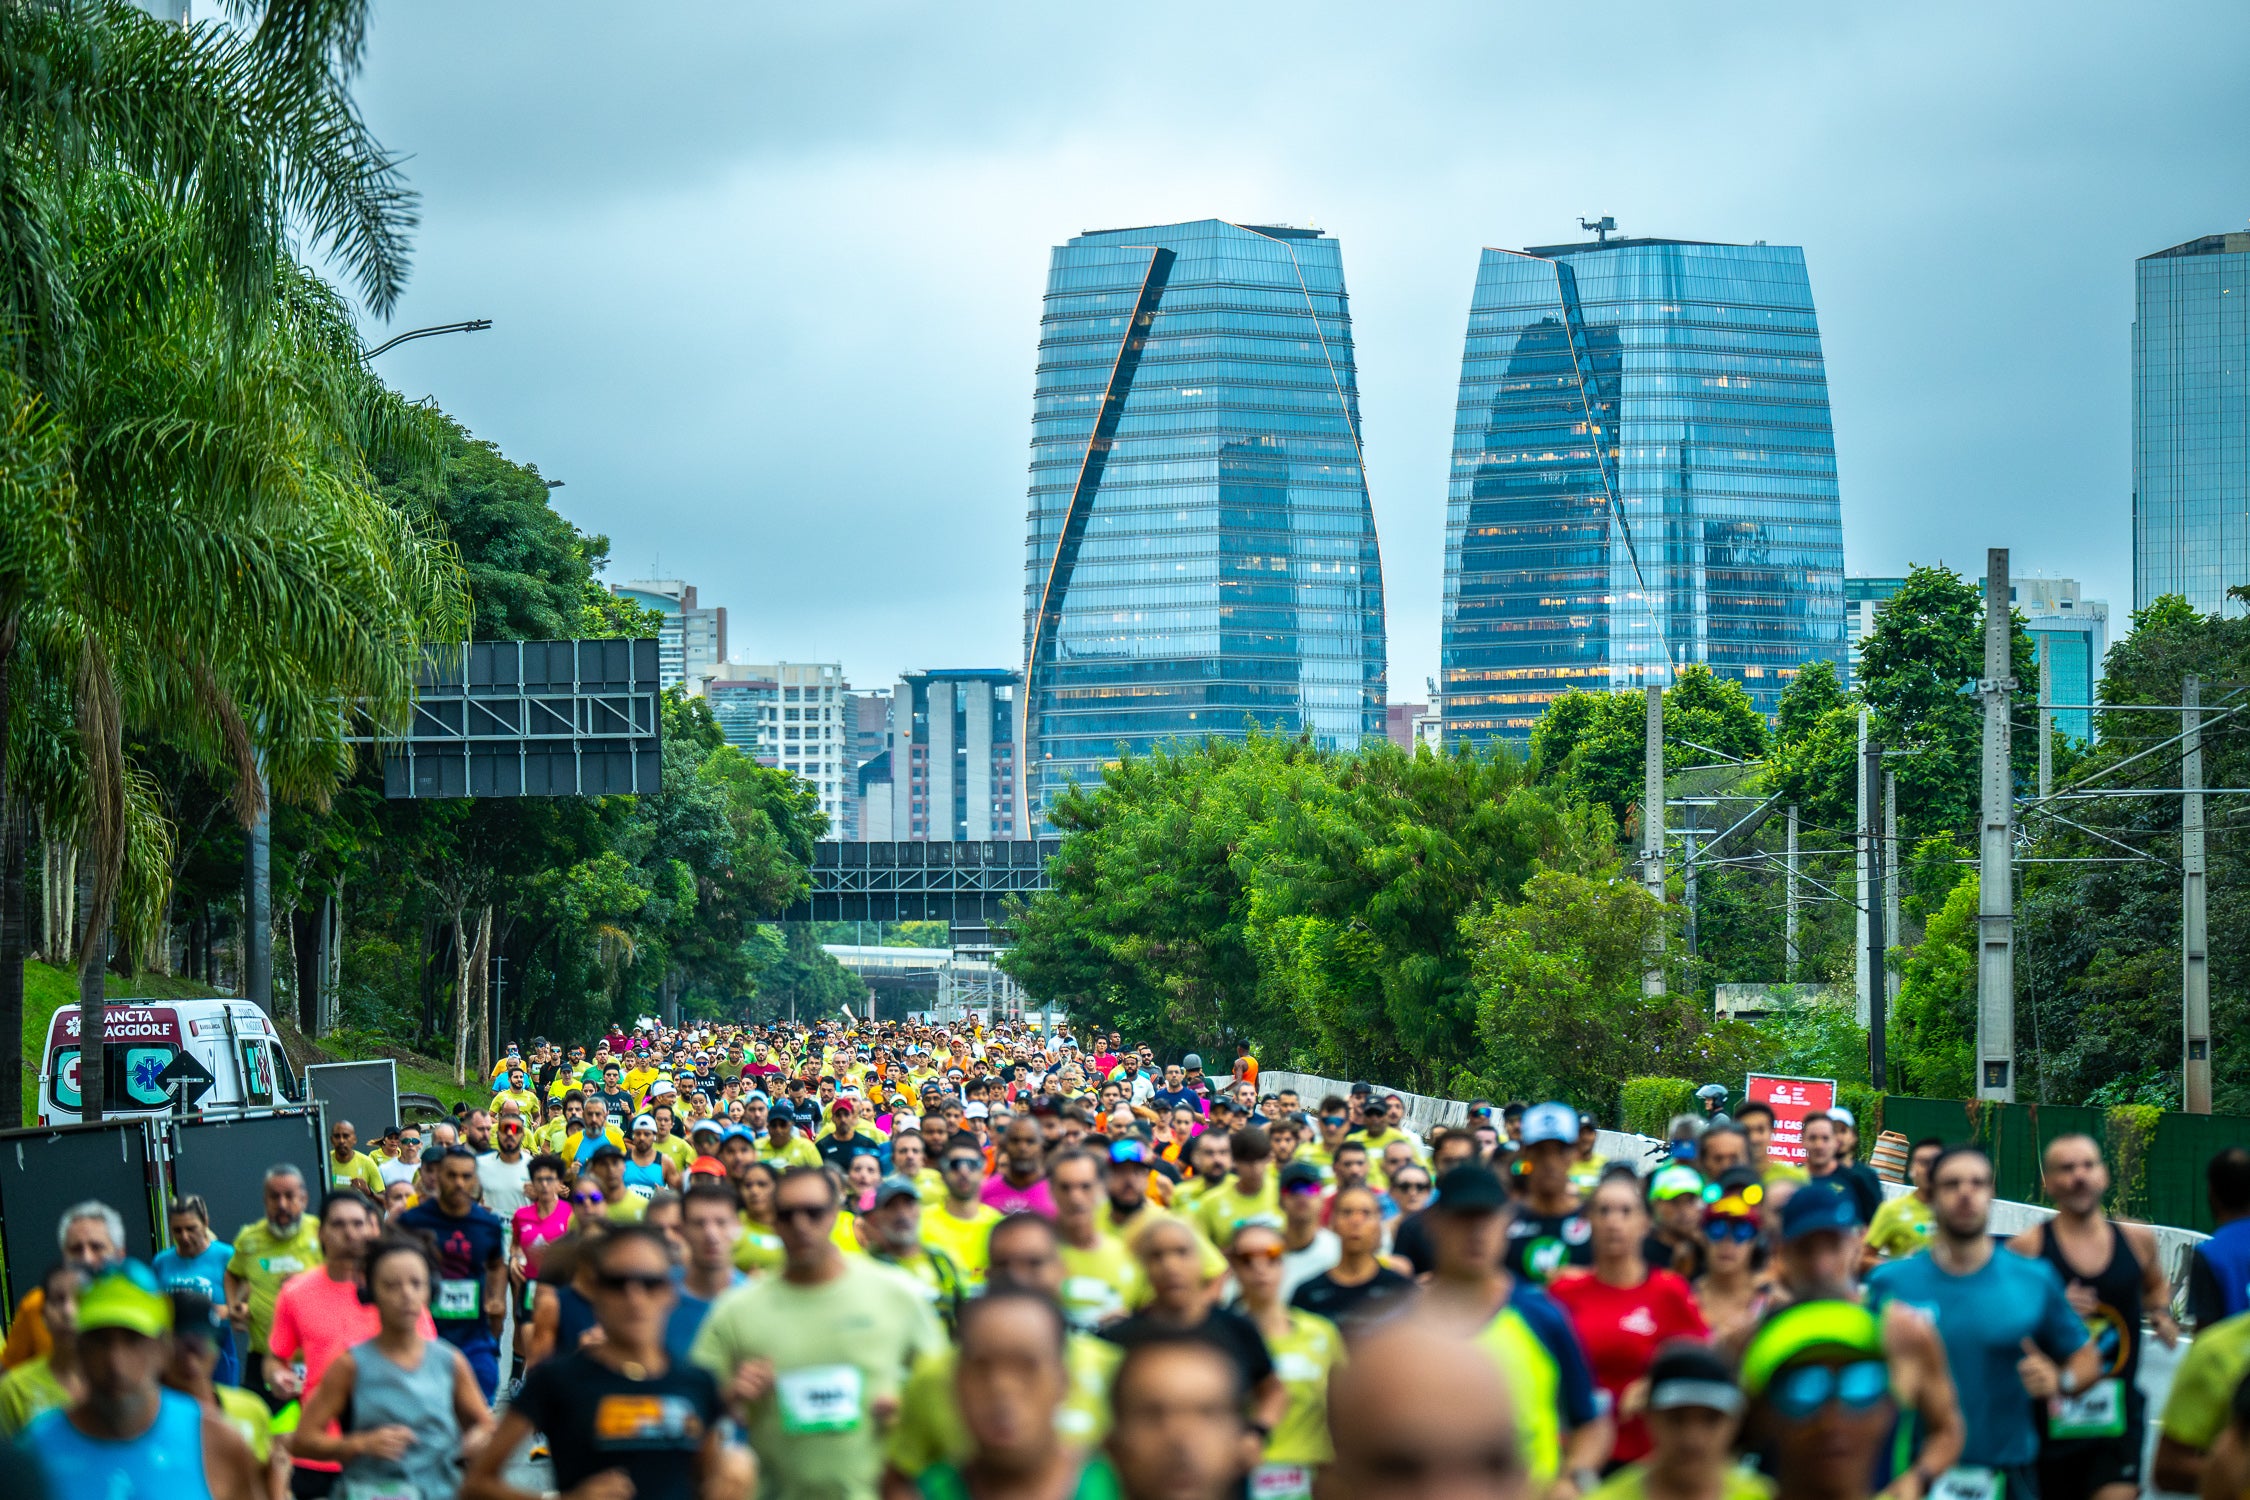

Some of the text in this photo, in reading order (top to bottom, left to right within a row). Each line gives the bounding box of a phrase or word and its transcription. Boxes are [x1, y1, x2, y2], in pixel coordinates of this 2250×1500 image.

[103, 1010, 153, 1023] ANCTA
[103, 1023, 171, 1037] AGGIORE
[1784, 1120, 1804, 1131] CAS
[1771, 1132, 1802, 1143] MERGÊ
[1766, 1145, 1809, 1158] DICA, LIG
